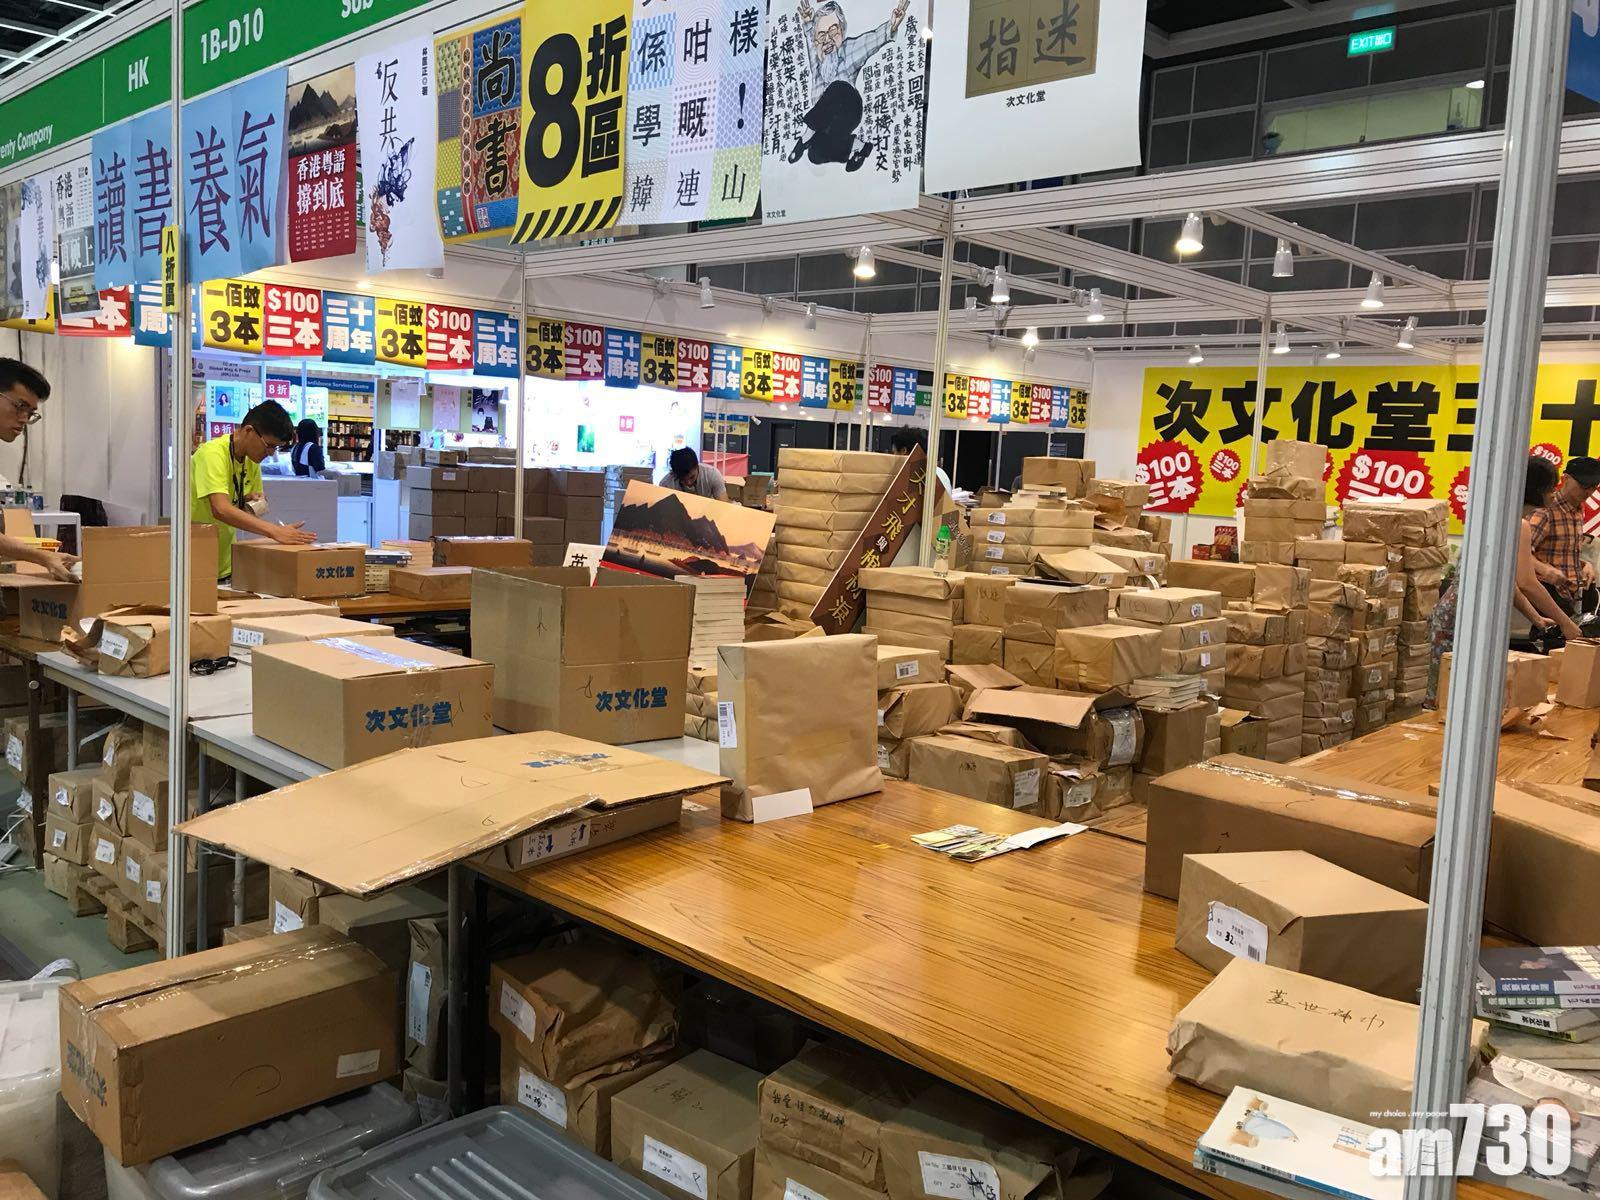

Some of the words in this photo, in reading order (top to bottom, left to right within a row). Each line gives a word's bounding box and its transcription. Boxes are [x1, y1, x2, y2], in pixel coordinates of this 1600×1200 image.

[200, 8, 264, 64] 1B-D10
[637, 9, 759, 76] 係咁樣
[1351, 34, 1376, 51] EXIT
[128, 56, 150, 92] HK
[582, 15, 628, 179] 折區
[1005, 90, 1046, 108] 次文化堂
[474, 29, 518, 198] 尚書
[525, 33, 583, 188] 8
[17, 123, 53, 150] Company
[296, 148, 346, 182] 香港粵語
[296, 177, 346, 217] 撐到底
[630, 163, 748, 214] 韓連山
[206, 283, 261, 310] 一佰蚊
[268, 290, 320, 314] $100
[326, 299, 373, 326] 三十
[378, 303, 424, 327] 一佰蚊
[428, 309, 471, 331] $100
[209, 310, 261, 345] 3本
[267, 316, 321, 350] 三本
[477, 316, 517, 343] 三十
[526, 321, 563, 344] 一佰蚊
[564, 327, 601, 347] $100
[327, 326, 374, 354] 周年
[381, 328, 424, 360] 3本
[427, 332, 472, 364] 三本
[607, 330, 639, 358] 三十
[642, 336, 676, 357] 一佰蚊
[678, 341, 709, 362] $100
[477, 342, 518, 368] 周年
[526, 344, 564, 375] 3本
[564, 347, 603, 377] 三本
[712, 345, 741, 369] 三十
[743, 351, 771, 371] 一佰蚊
[773, 354, 800, 373] $100
[607, 356, 639, 380] 周年
[643, 356, 676, 386] 3本
[678, 361, 709, 389] 三本
[711, 369, 741, 391] 周年
[803, 358, 828, 382] 三十
[831, 360, 856, 380] 一佰蚊
[869, 367, 892, 383] $100
[268, 384, 287, 395] 8折
[743, 370, 772, 396] 3本
[773, 374, 801, 399] 三本
[803, 379, 828, 401] 周年
[832, 381, 855, 403] 3本
[894, 371, 917, 390] 三十
[969, 377, 991, 393] $100
[992, 381, 1011, 398] 三十
[869, 386, 891, 407] 三本
[894, 389, 916, 408] 周年
[947, 393, 968, 414] 3本
[968, 394, 990, 416] 三本
[1033, 385, 1051, 401] $100
[1012, 401, 1030, 419] 3本
[1030, 402, 1051, 421] 三本
[1071, 406, 1087, 424] 3本
[1135, 451, 1192, 484] $100
[1216, 451, 1240, 471] $100
[1534, 445, 1561, 466] $100
[1210, 459, 1235, 479] 三本
[1351, 453, 1425, 495] $100
[1142, 475, 1197, 510] 三本
[315, 566, 356, 579] 次文化堂
[595, 686, 668, 712] 次文化堂
[365, 701, 452, 733] 次文化堂
